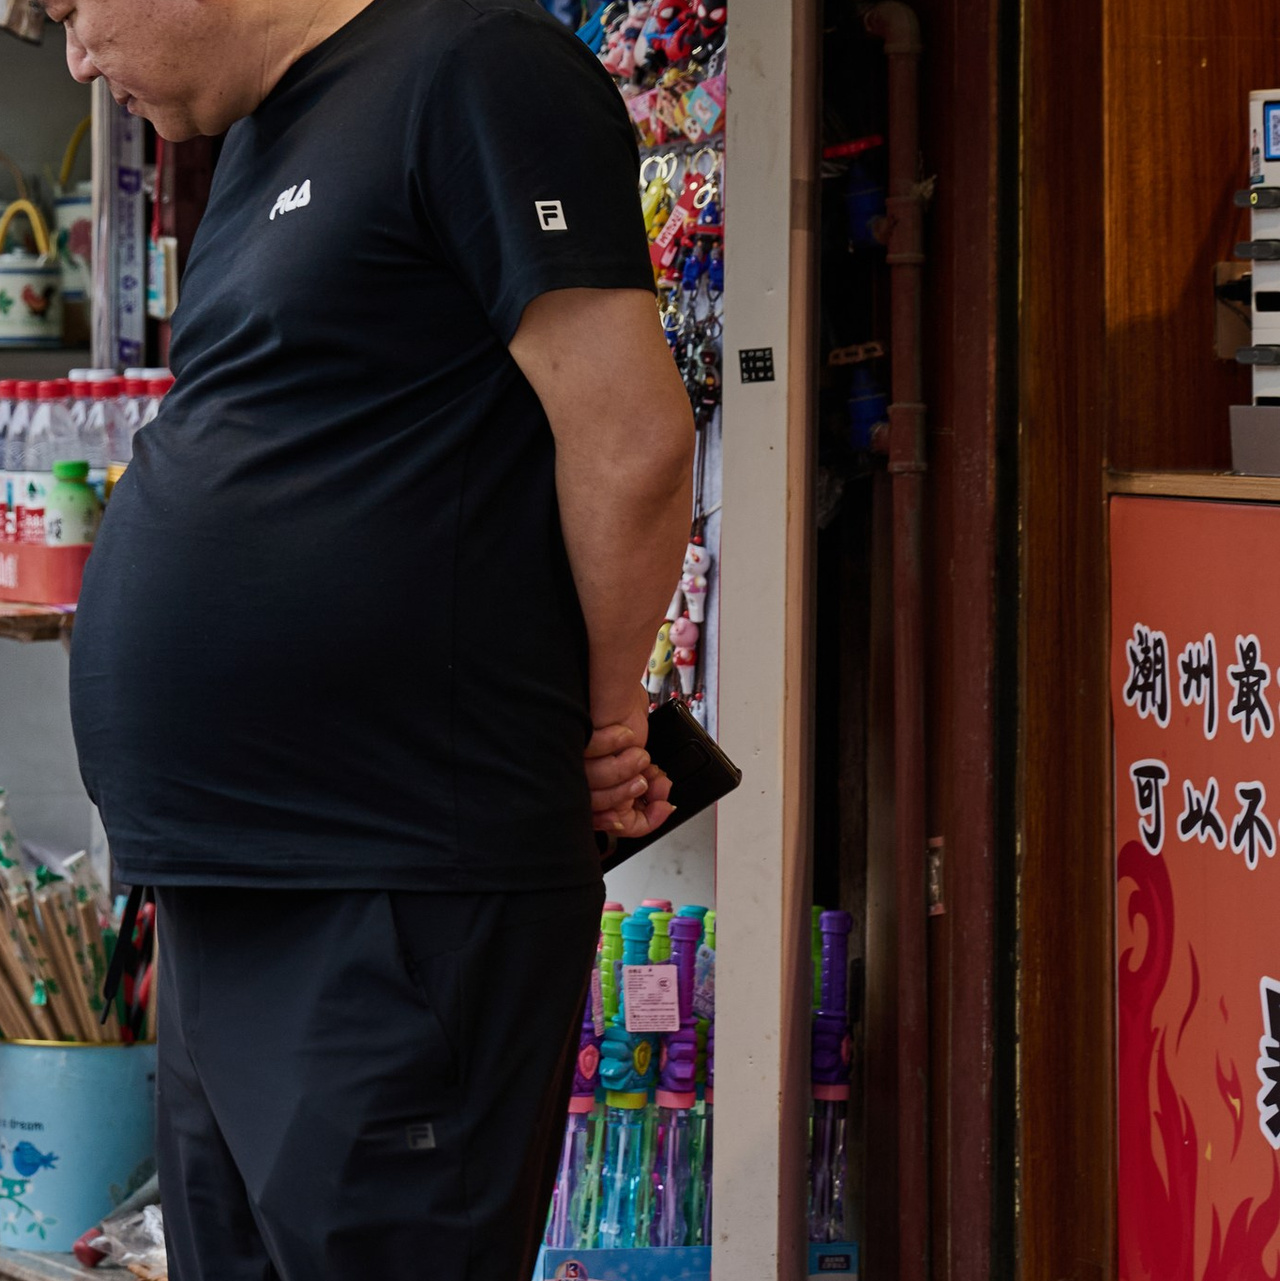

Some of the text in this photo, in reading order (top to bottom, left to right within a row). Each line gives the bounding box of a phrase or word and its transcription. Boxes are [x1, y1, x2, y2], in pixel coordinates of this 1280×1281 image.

[268, 178, 312, 221] FILA
[1125, 626, 1272, 738] 潮州最
[1131, 764, 1274, 865] 可以不
